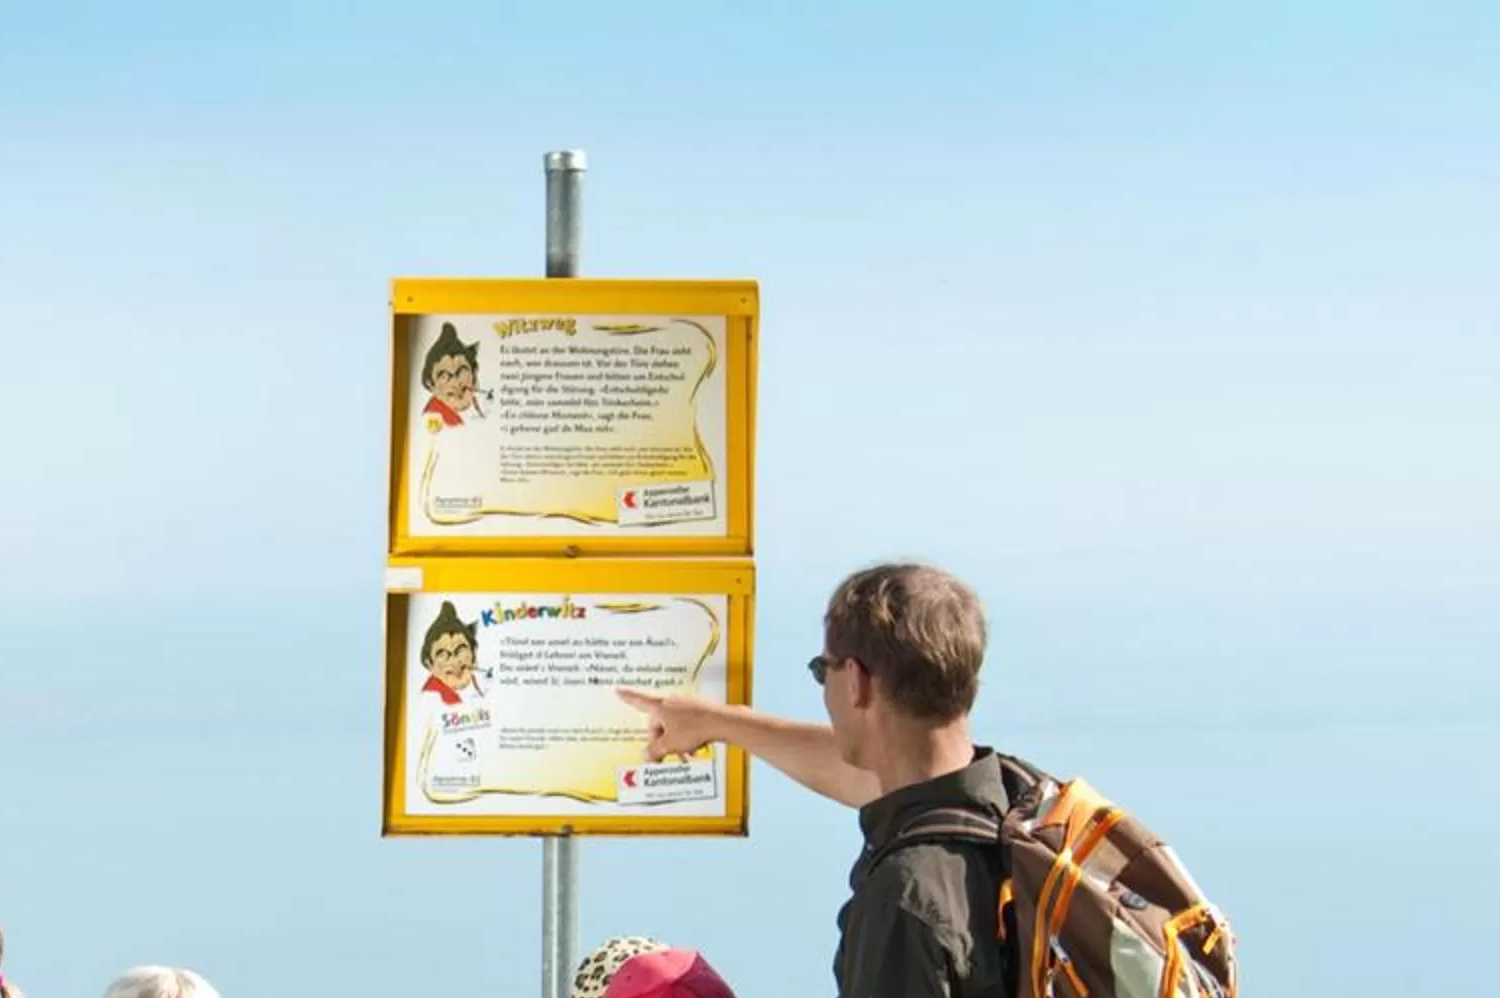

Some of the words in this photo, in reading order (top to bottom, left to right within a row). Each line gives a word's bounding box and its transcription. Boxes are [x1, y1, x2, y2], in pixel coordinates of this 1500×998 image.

[492, 319, 577, 339] Witzweg
[634, 345, 648, 355] Die
[650, 345, 669, 355] Frau
[597, 358, 610, 368] Vor
[615, 358, 628, 368] der
[556, 371, 584, 381] Frauen
[587, 371, 603, 381] und
[605, 371, 631, 381] bitten
[532, 384, 543, 394] für
[546, 384, 559, 394] die
[598, 411, 615, 422] sagt
[617, 410, 629, 420] die
[644, 493, 710, 508] Kantonalbank
[481, 597, 587, 627] Kinderwitz
[644, 773, 710, 787] Kantonalbank
